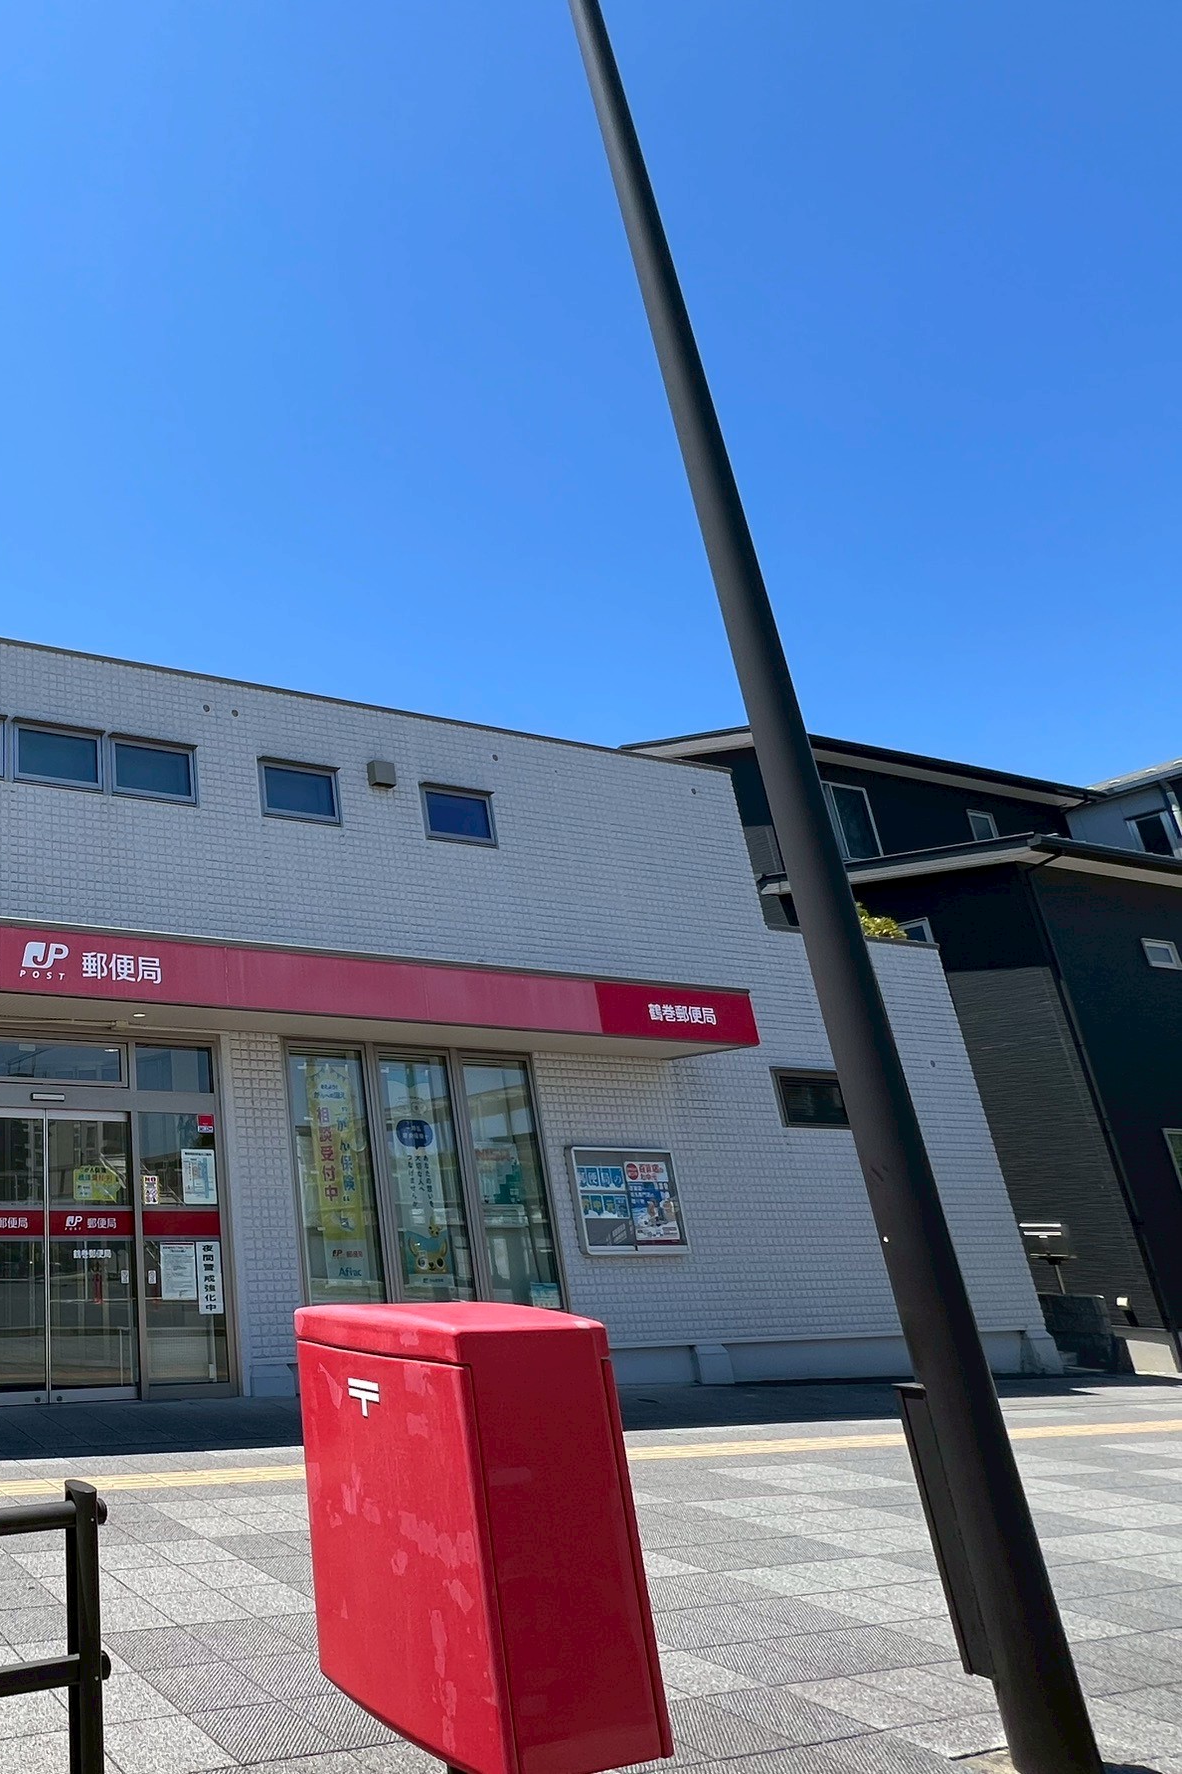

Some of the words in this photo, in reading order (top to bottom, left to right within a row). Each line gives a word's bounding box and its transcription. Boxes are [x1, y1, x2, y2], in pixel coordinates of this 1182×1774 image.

[21, 941, 69, 969] JP
[82, 951, 162, 984] 郵便局
[20, 970, 65, 981] POST
[648, 1003, 717, 1026] 鶴巻郵便局
[317, 1106, 339, 1202] 相談受付中
[87, 1217, 117, 1229] 郵便局
[73, 1249, 112, 1259] 鶴巻郵便局
[202, 1244, 217, 1312] 夜間警戒強化中
[338, 1267, 362, 1277] Aflac
